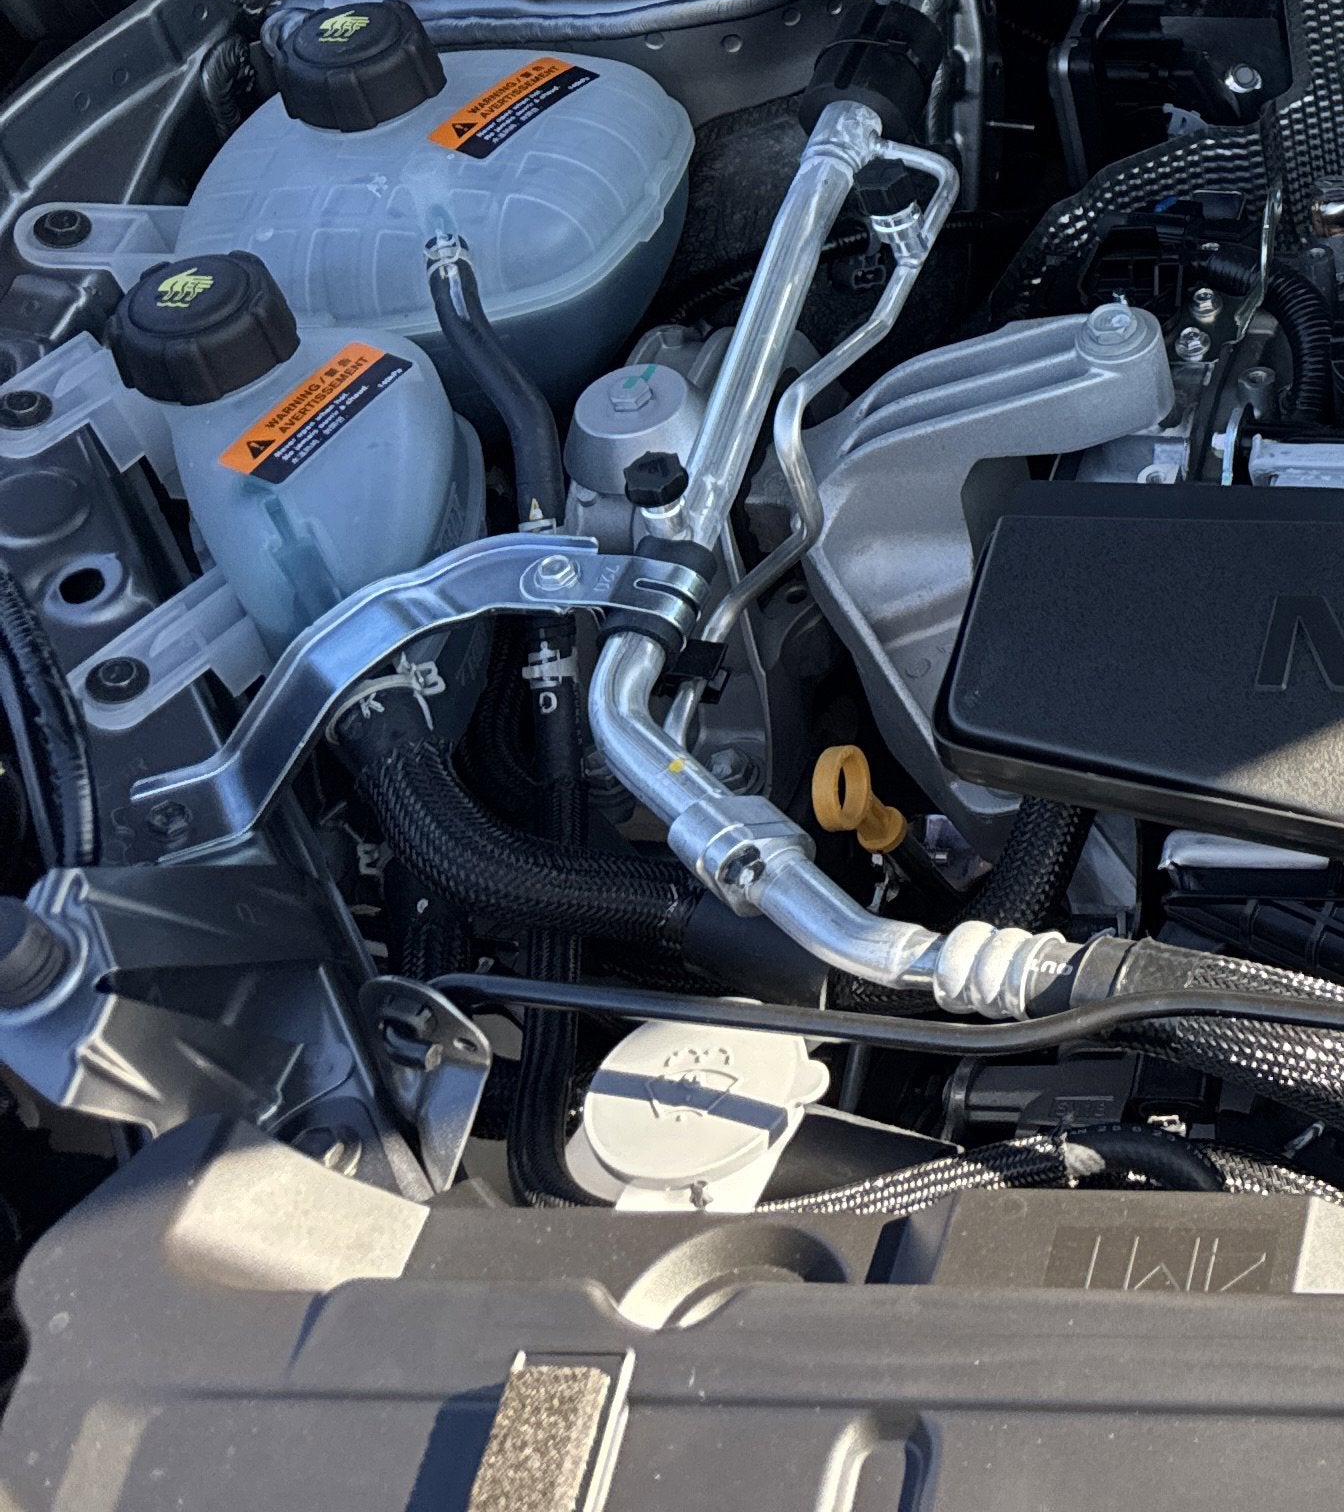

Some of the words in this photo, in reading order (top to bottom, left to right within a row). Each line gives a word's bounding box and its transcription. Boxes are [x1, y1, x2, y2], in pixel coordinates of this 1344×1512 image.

[467, 79, 519, 115] WARNING
[480, 64, 561, 119] AVERTISSEMENT
[266, 383, 320, 431] WARNING
[279, 356, 369, 435] AVERTISSEMENT
